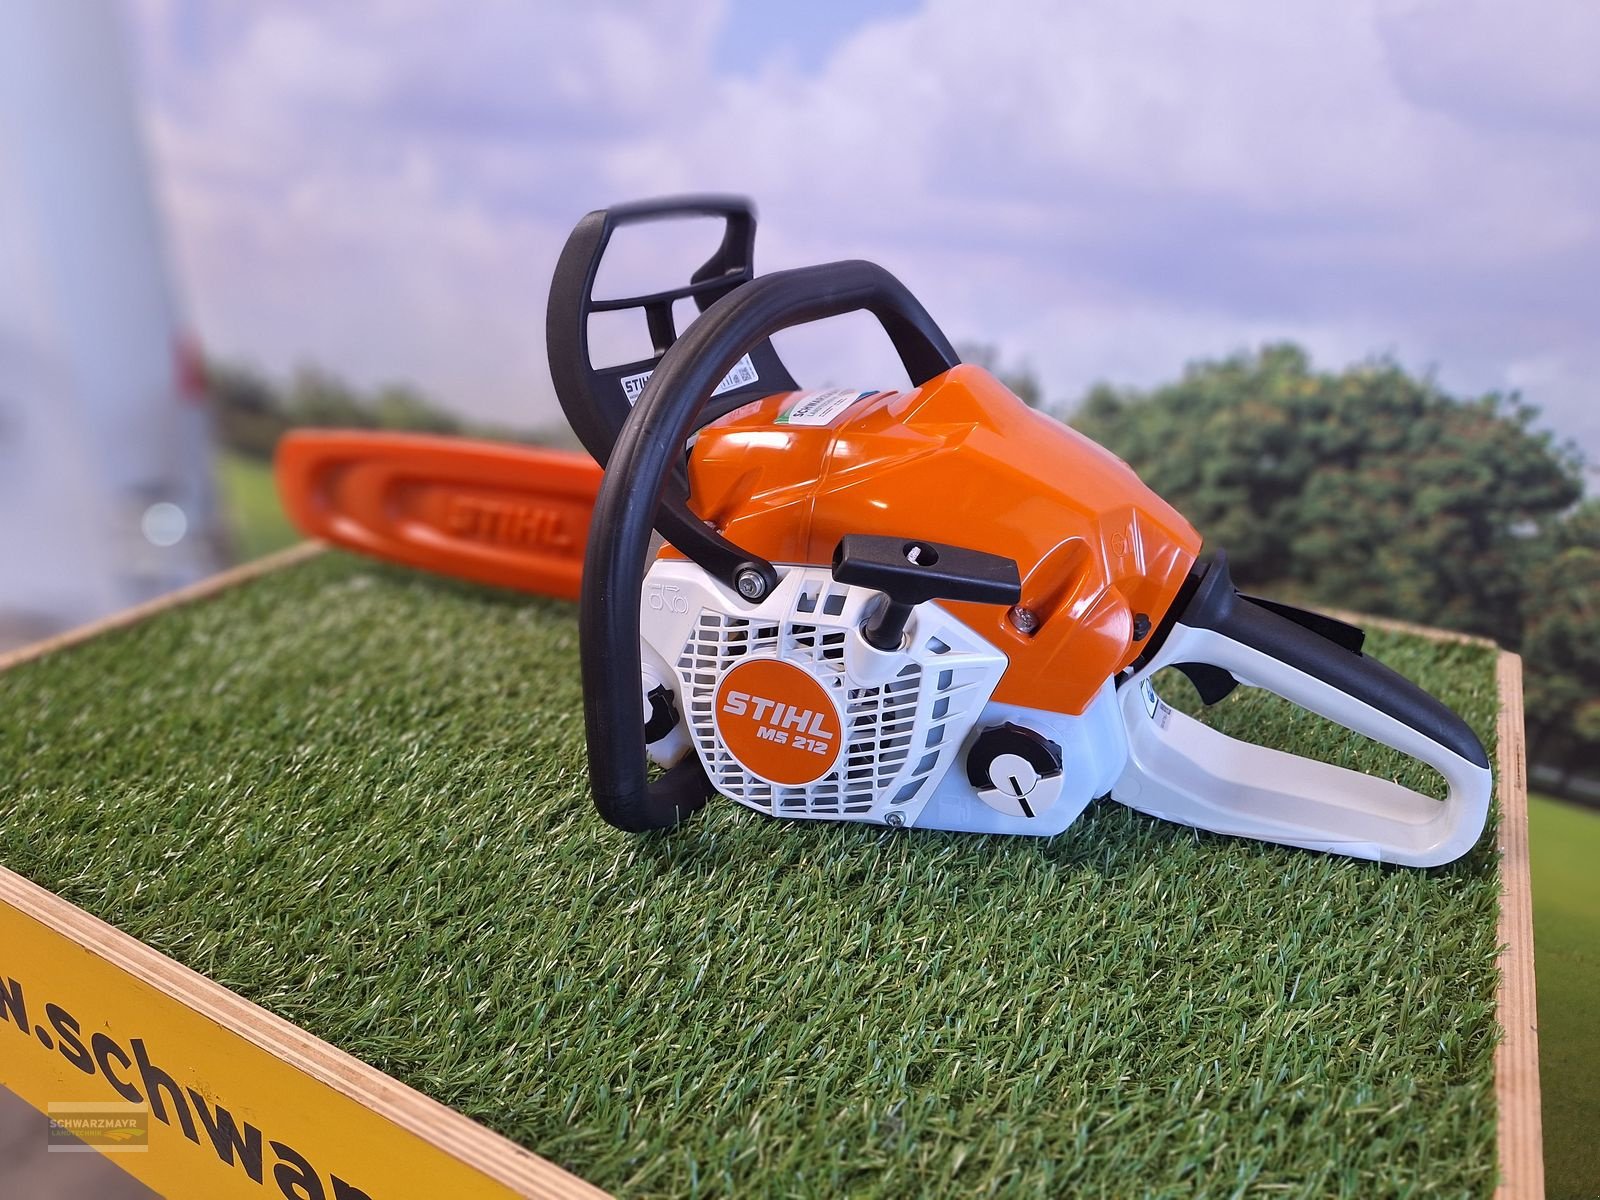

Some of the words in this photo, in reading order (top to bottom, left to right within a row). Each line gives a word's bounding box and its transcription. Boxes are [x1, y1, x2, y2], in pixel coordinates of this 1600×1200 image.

[449, 497, 572, 549] STIHL
[723, 690, 833, 740] STIHL
[756, 726, 788, 744] MS
[792, 735, 828, 755] 212
